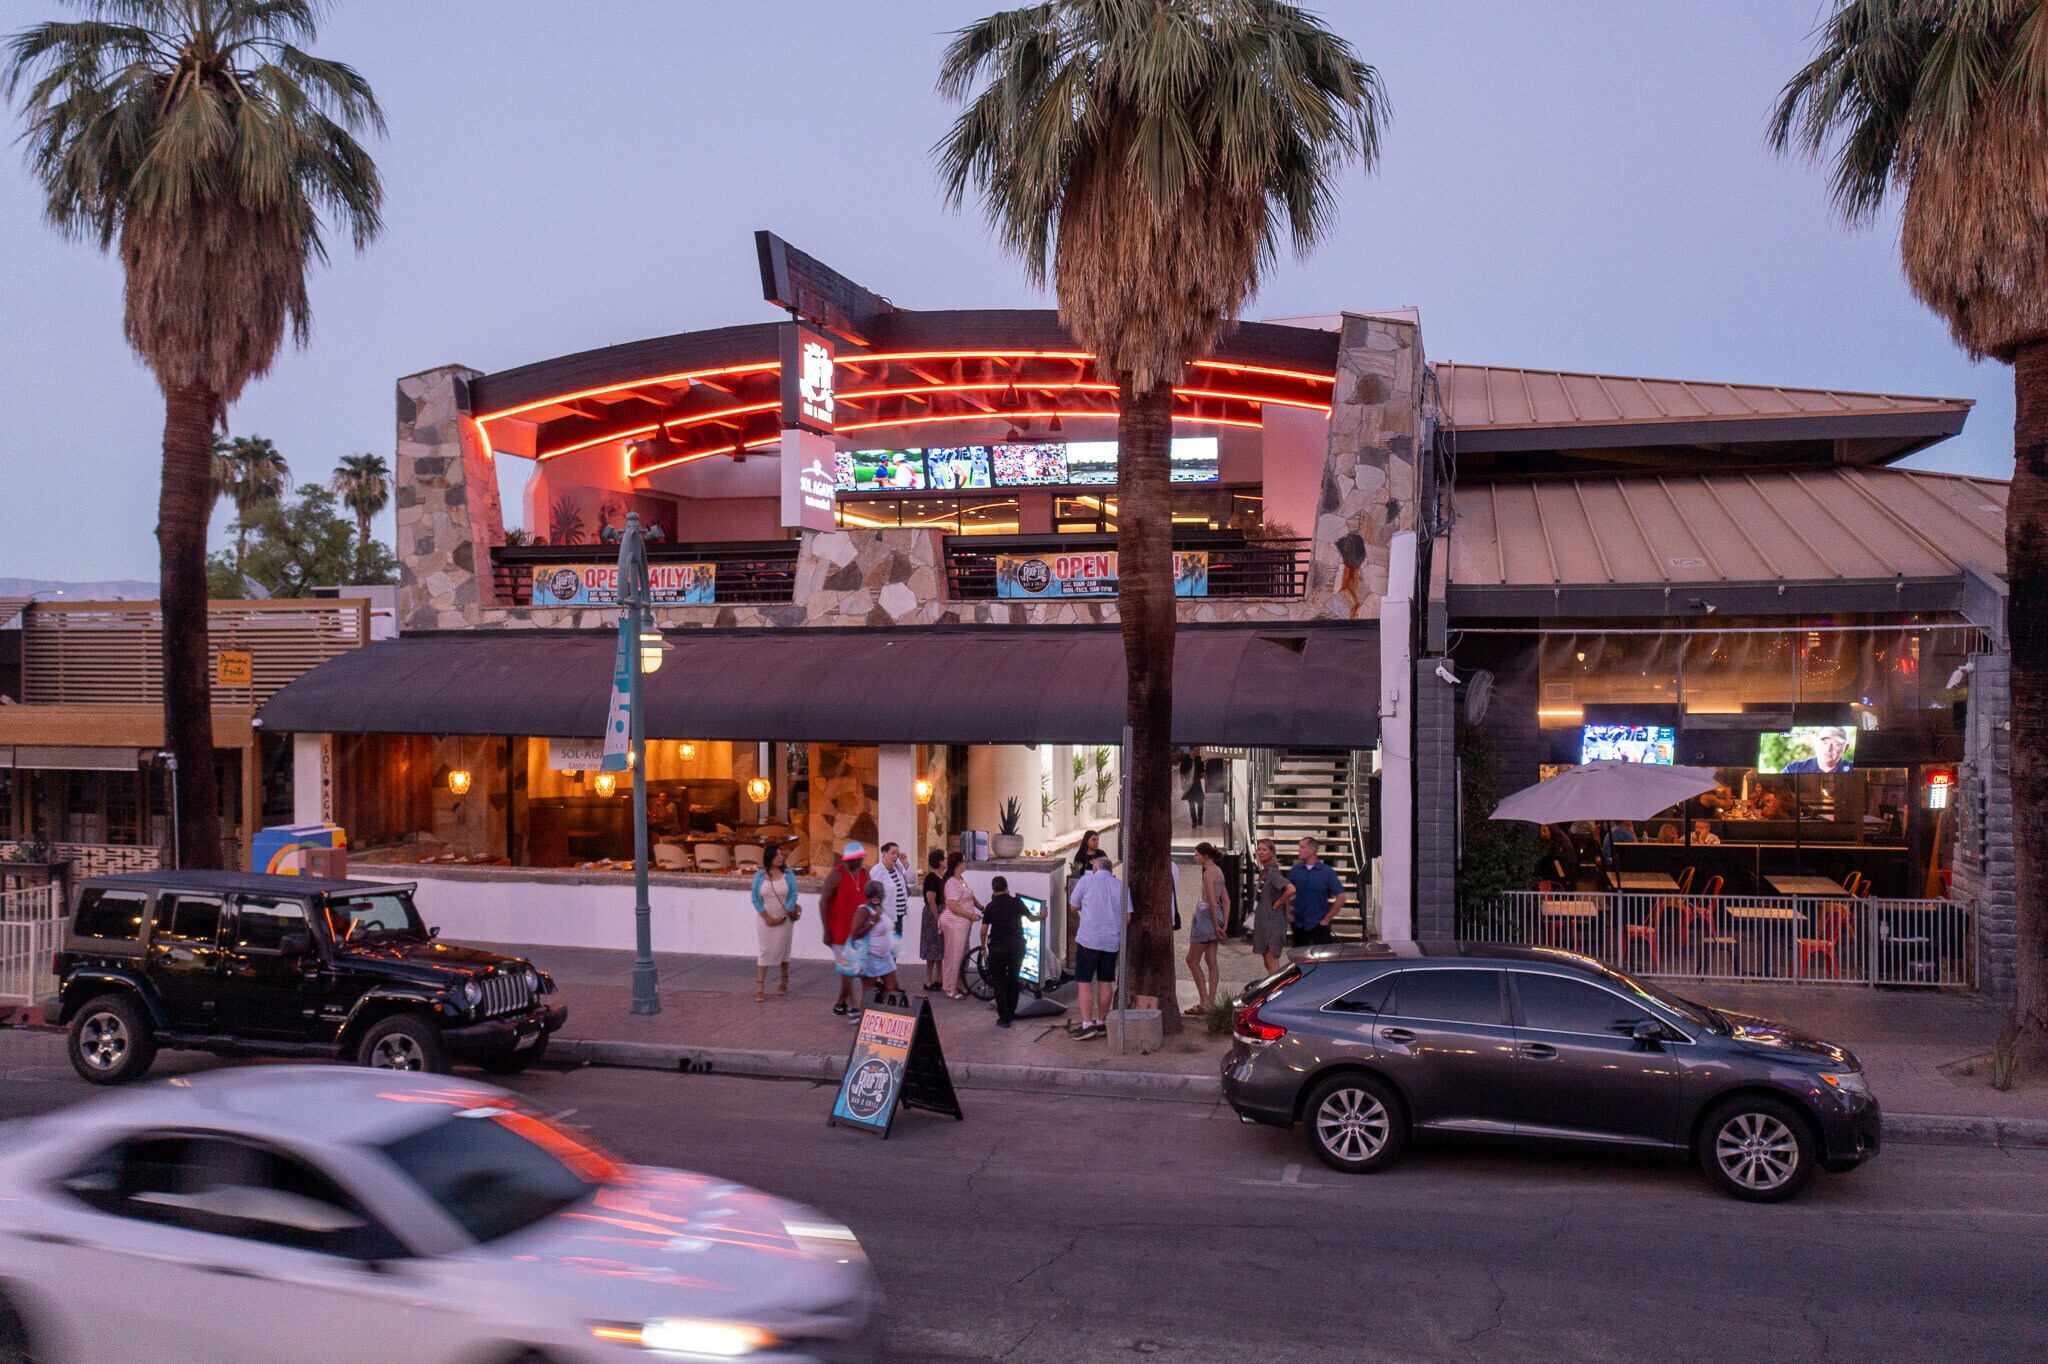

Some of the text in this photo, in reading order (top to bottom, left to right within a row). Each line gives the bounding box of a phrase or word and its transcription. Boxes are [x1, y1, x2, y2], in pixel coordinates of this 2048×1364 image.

[584, 566, 694, 590] OPE AILY!
[1055, 555, 1110, 580] OPEN
[1206, 745, 1243, 755] ELEVATOR
[1933, 775, 1948, 784] OPEN
[323, 790, 331, 820] AGA
[862, 1013, 885, 1035] OPEN
[885, 1018, 913, 1041] DAILY!
